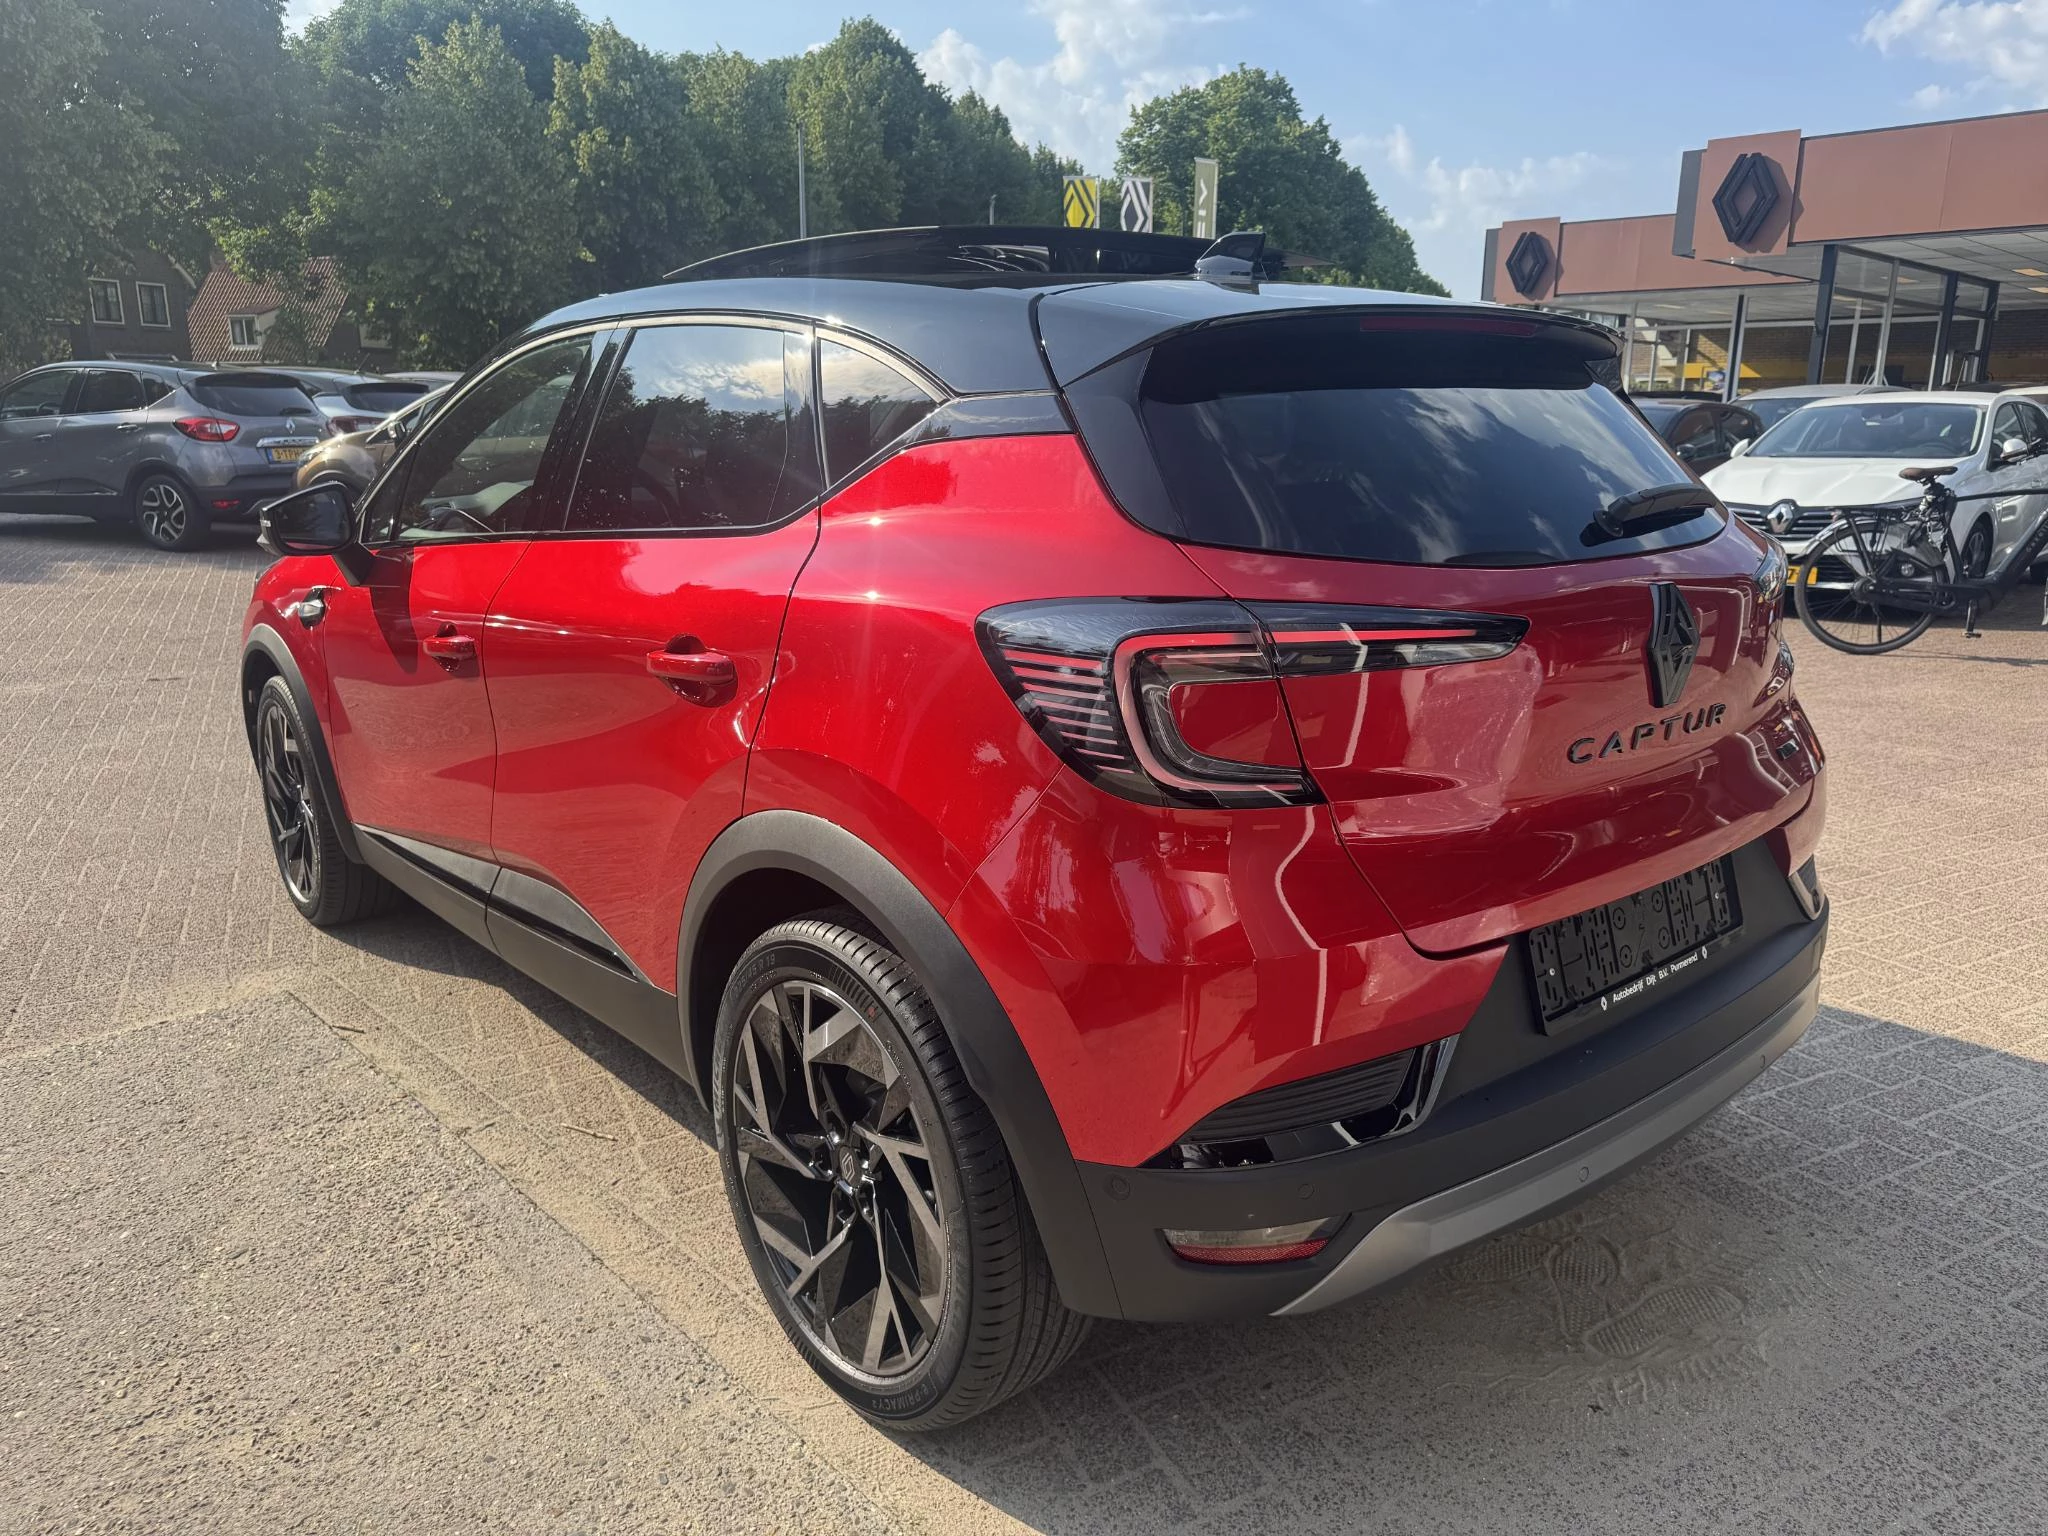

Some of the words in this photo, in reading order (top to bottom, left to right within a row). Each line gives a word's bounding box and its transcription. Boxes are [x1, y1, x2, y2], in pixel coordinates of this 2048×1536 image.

[1567, 703, 1727, 764] CAPTUR
[1613, 979, 1644, 1002] Autobedrijf
[1658, 967, 1668, 979] B.V.
[1670, 952, 1698, 973] Purmerend
